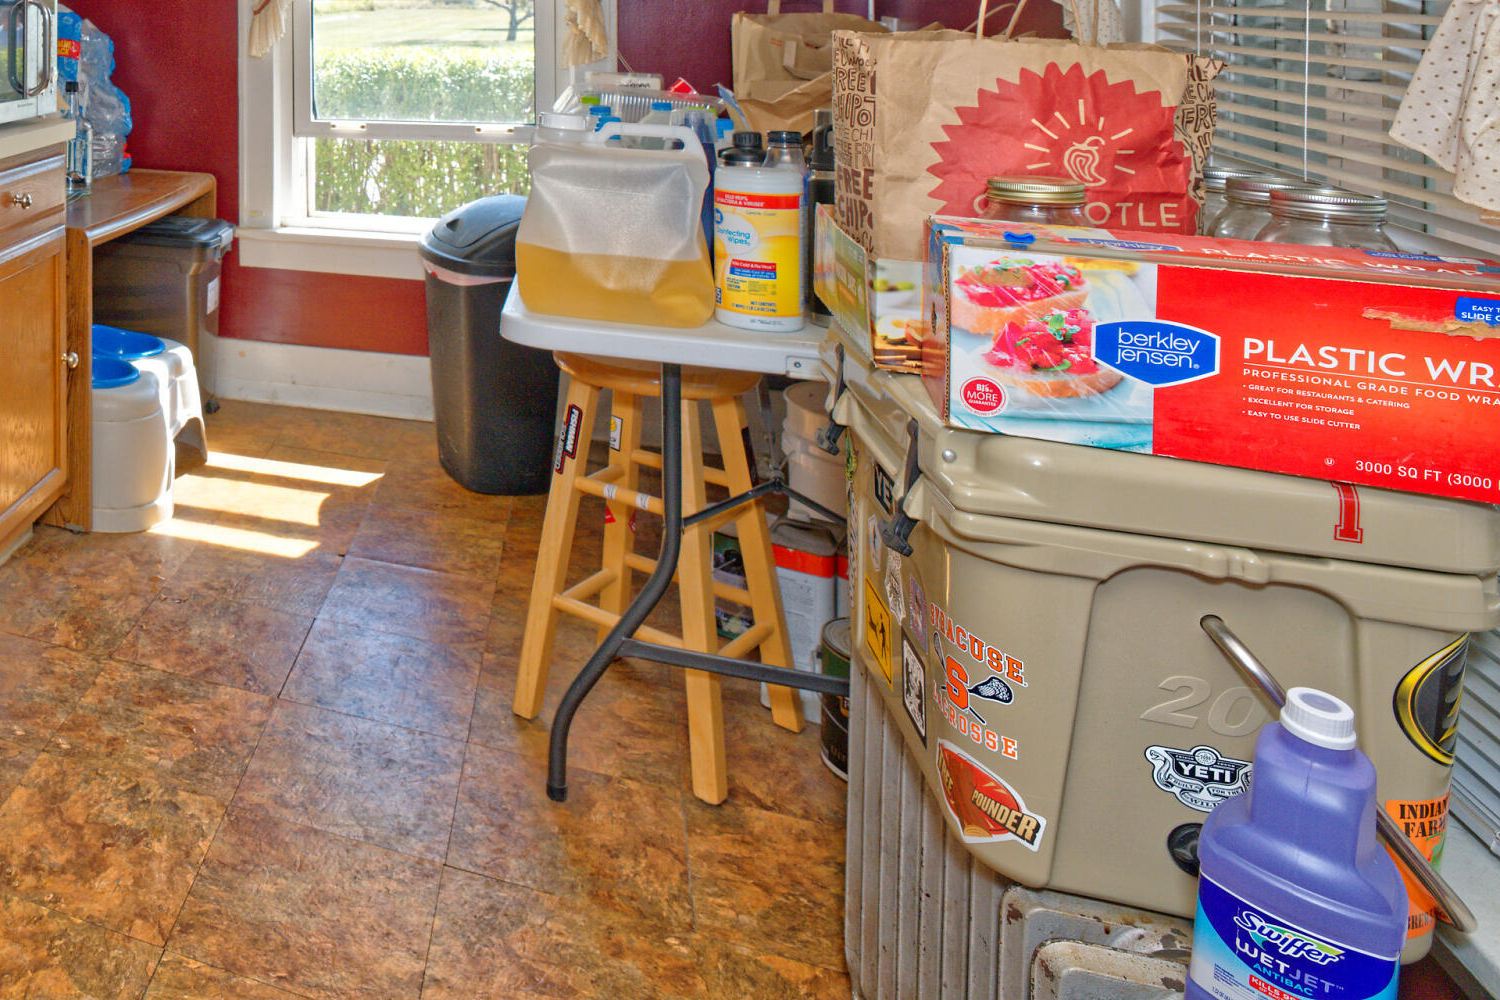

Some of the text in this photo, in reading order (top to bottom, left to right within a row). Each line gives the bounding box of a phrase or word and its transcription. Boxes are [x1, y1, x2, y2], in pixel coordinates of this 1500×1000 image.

[973, 194, 1180, 227] COTLE
[1461, 312, 1492, 321] SLIDE
[1119, 327, 1200, 354] berkley
[1116, 348, 1193, 369] jensen
[1243, 337, 1500, 388] PLASTIC WR
[967, 391, 998, 402] MORE
[1243, 368, 1500, 406] PROFESSIONAL GRADE FOOD WRA
[1248, 384, 1275, 394] GREAT
[1276, 387, 1294, 395] FOR
[1296, 389, 1355, 402] RESTAURANTS
[1366, 398, 1410, 409] CATERING
[1248, 397, 1354, 416] EXCELLENT FOR STORAGE
[1248, 410, 1268, 418] EASY
[1301, 416, 1325, 426] SLIDE
[1327, 420, 1361, 430] CUTTER
[1355, 460, 1492, 489] 3000 SQ FT (3000
[930, 603, 1027, 687] SYRACUSE
[946, 655, 970, 711] S
[933, 680, 1018, 760] LACROSSE
[1140, 676, 1269, 737] 20
[1178, 762, 1231, 783] YETI
[971, 789, 1041, 846] POUNDER
[1233, 911, 1340, 966] Swiffer
[1252, 976, 1281, 996] KILLS
[1253, 962, 1315, 996] ANTIBAC
